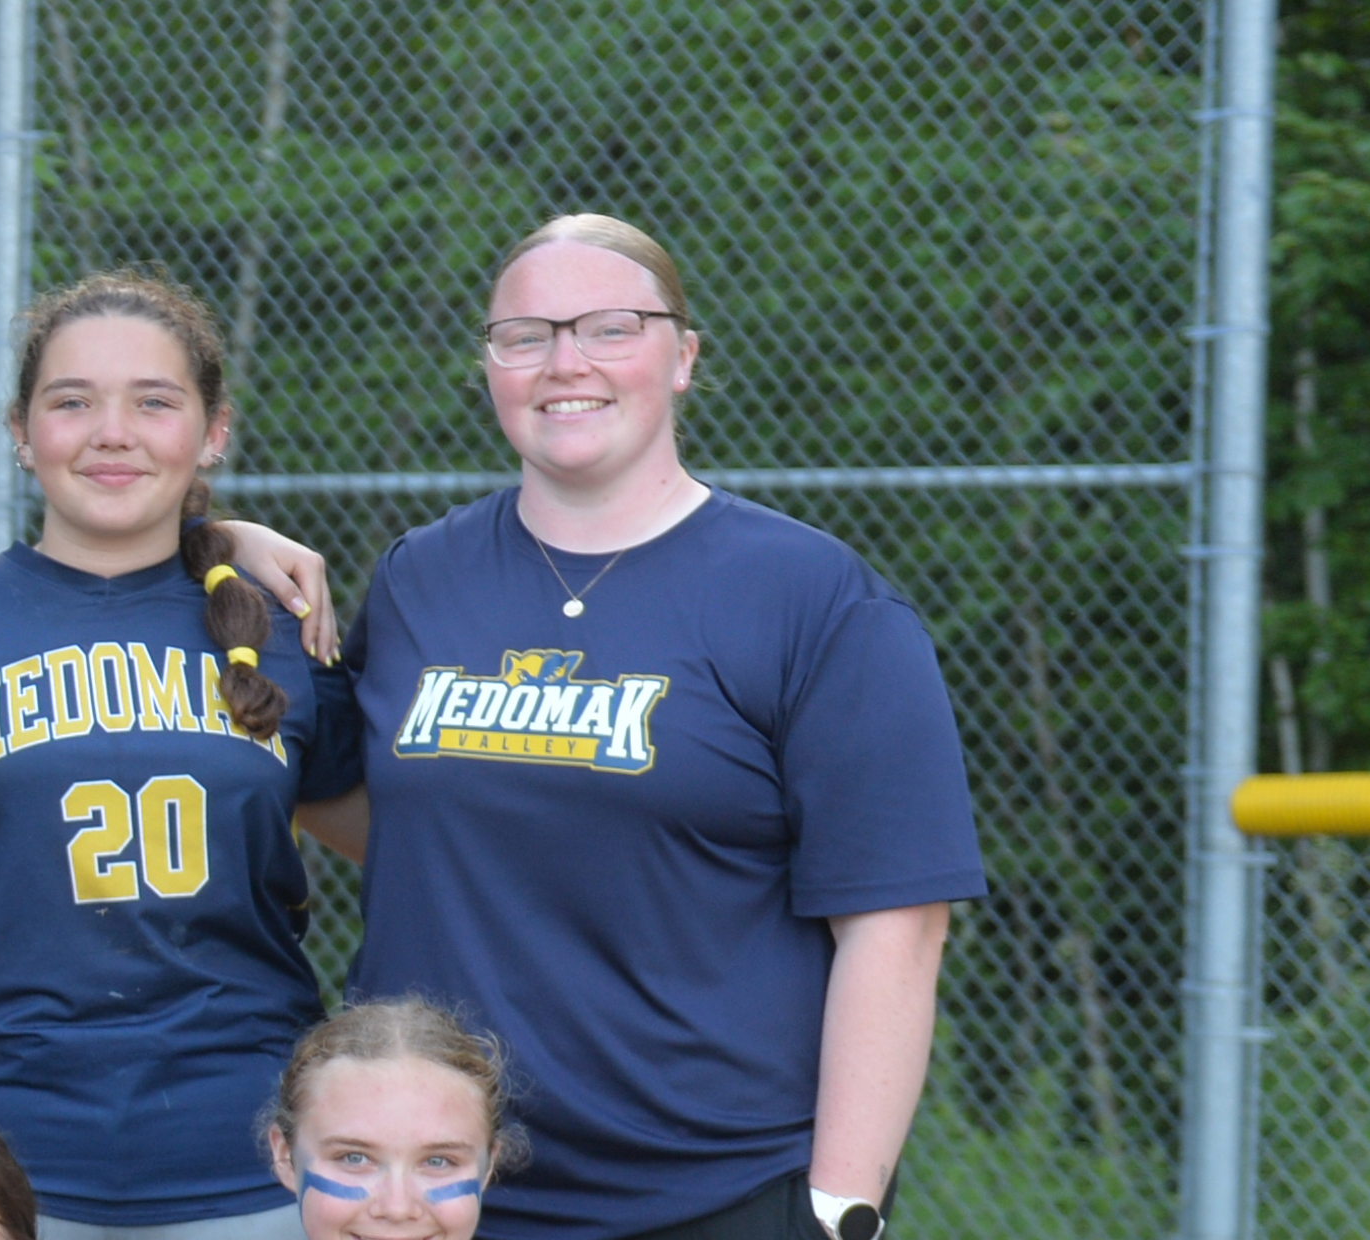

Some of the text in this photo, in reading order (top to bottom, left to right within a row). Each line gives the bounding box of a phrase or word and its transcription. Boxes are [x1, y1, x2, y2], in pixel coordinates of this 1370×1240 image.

[398, 671, 661, 760] MEDOMAK
[458, 733, 578, 755] VALLEY
[61, 774, 209, 904] 20
